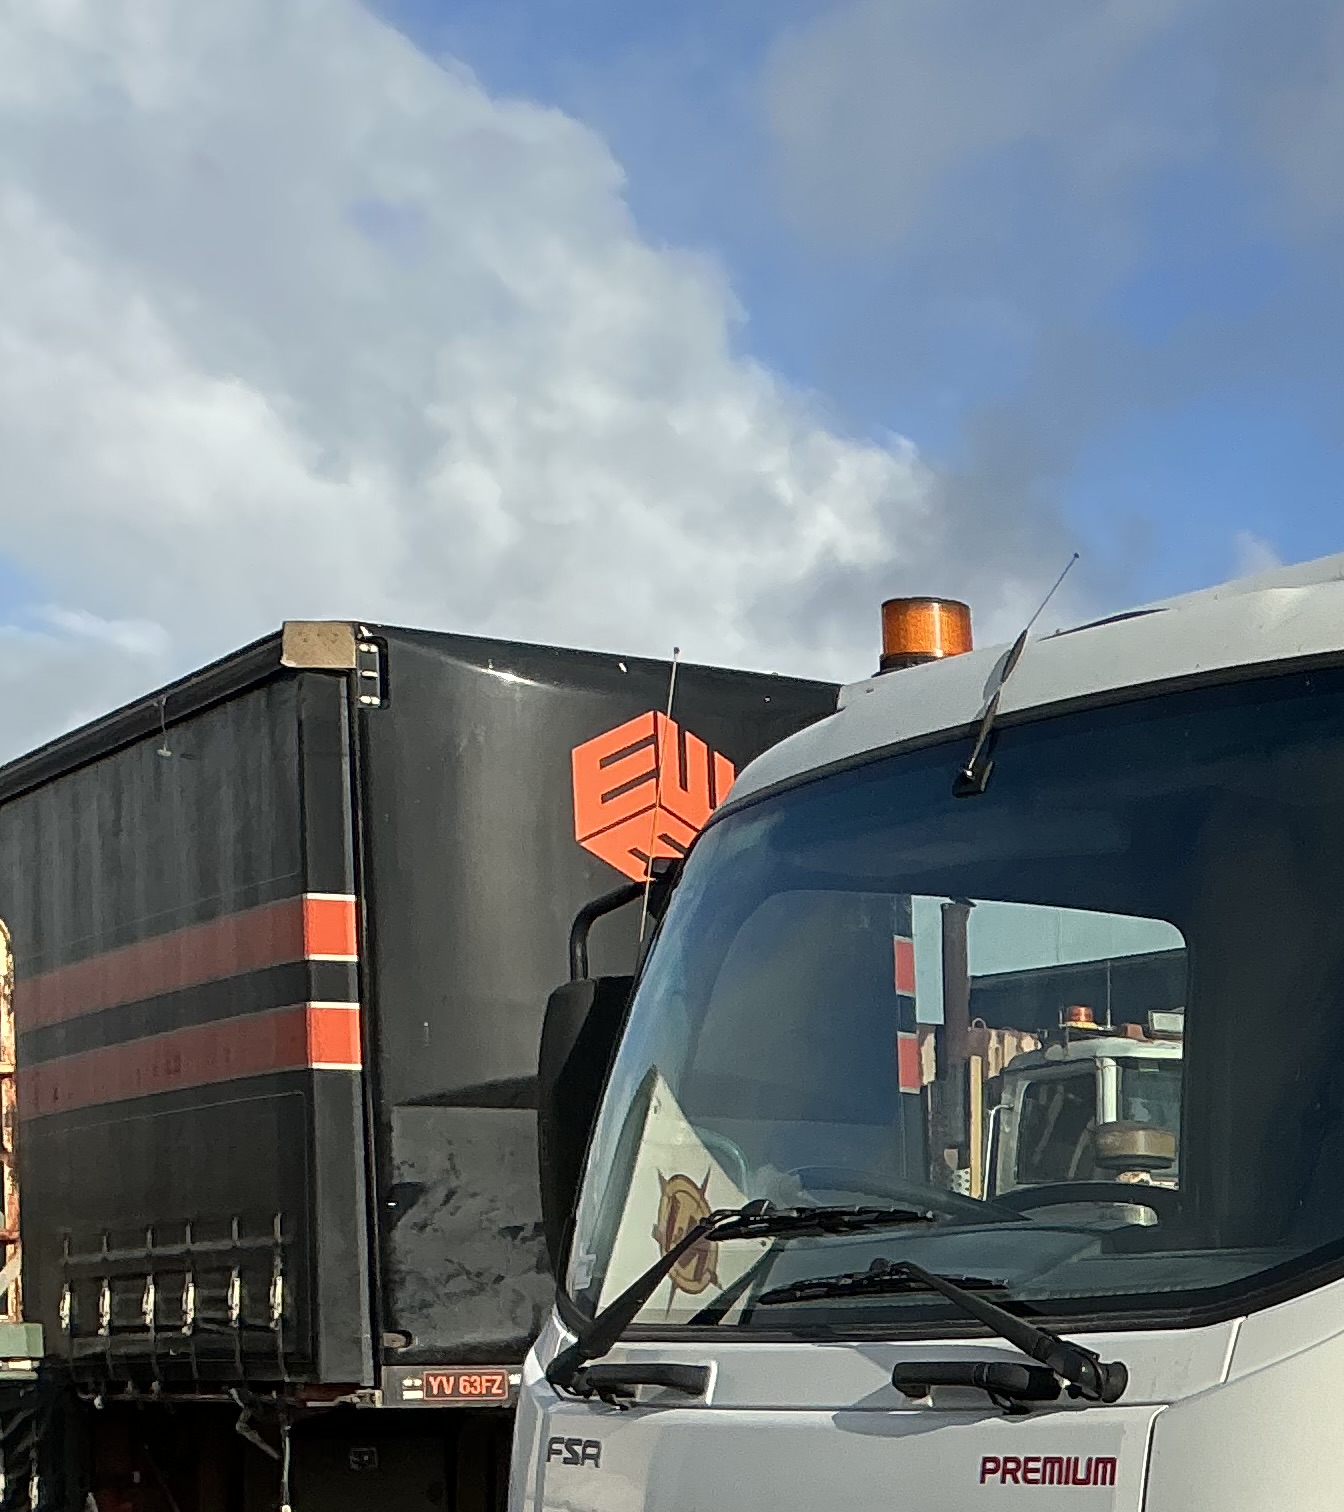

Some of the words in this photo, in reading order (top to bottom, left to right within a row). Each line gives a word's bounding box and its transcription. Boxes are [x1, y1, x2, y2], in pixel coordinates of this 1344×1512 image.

[428, 1375, 455, 1395] YV
[459, 1375, 504, 1395] 63FZ
[546, 1436, 602, 1469] FSR
[979, 1456, 1117, 1486] PREMIUM
